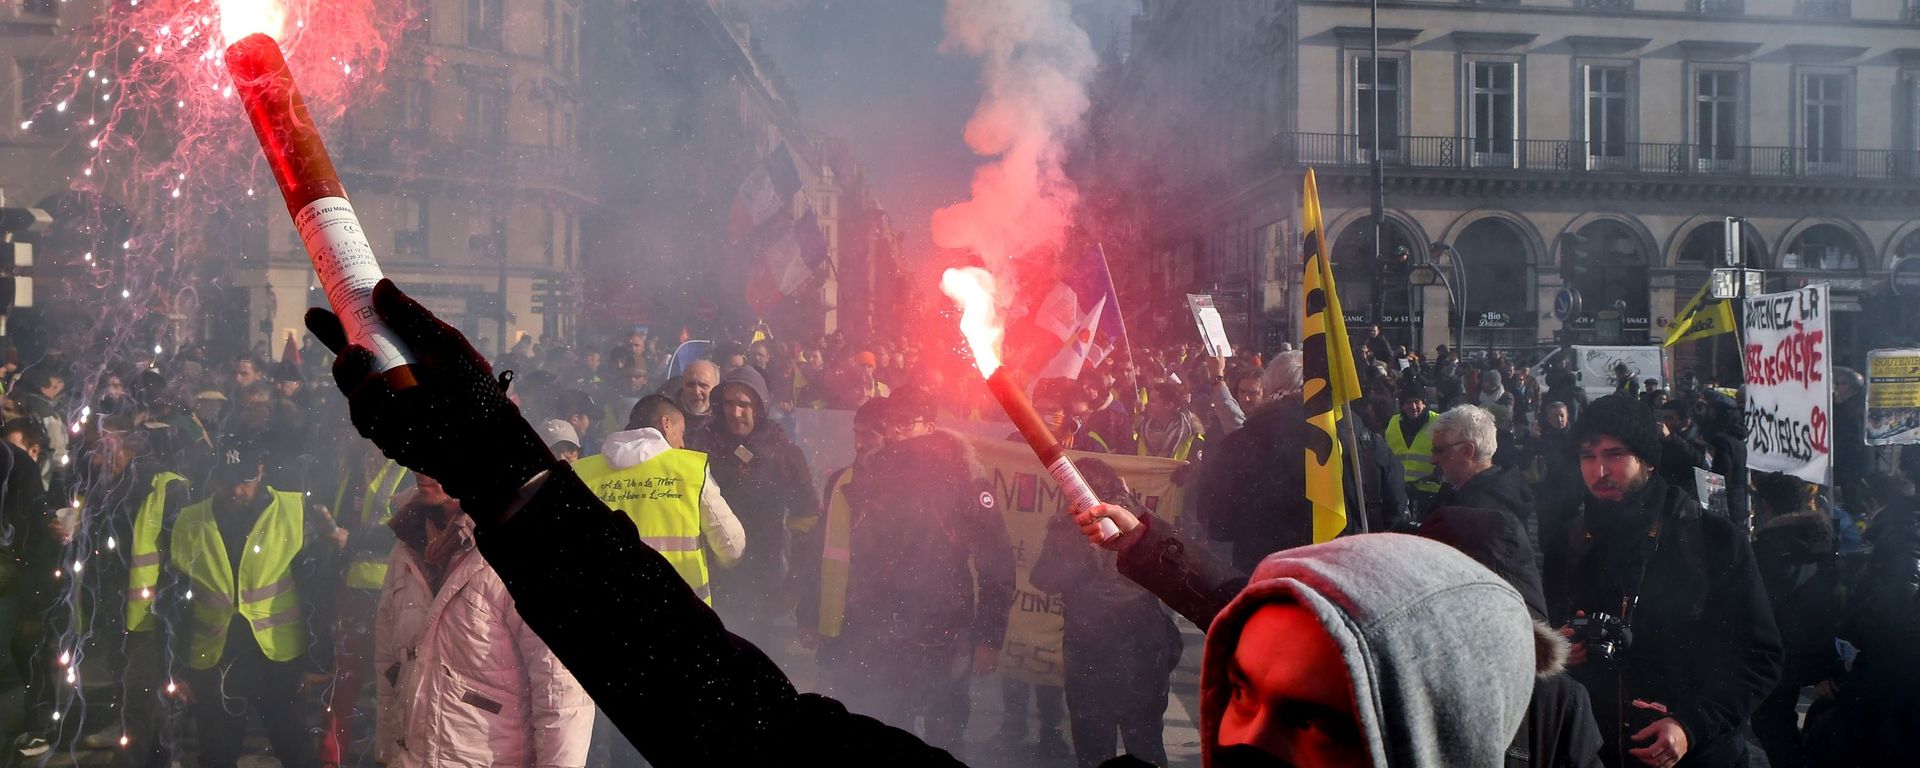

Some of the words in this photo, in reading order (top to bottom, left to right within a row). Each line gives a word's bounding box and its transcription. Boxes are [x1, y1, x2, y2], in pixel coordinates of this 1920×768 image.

[321, 206, 334, 215] FEU
[1799, 288, 1819, 320] LA
[1488, 312, 1501, 320] Bio
[1811, 405, 1829, 454] 92
